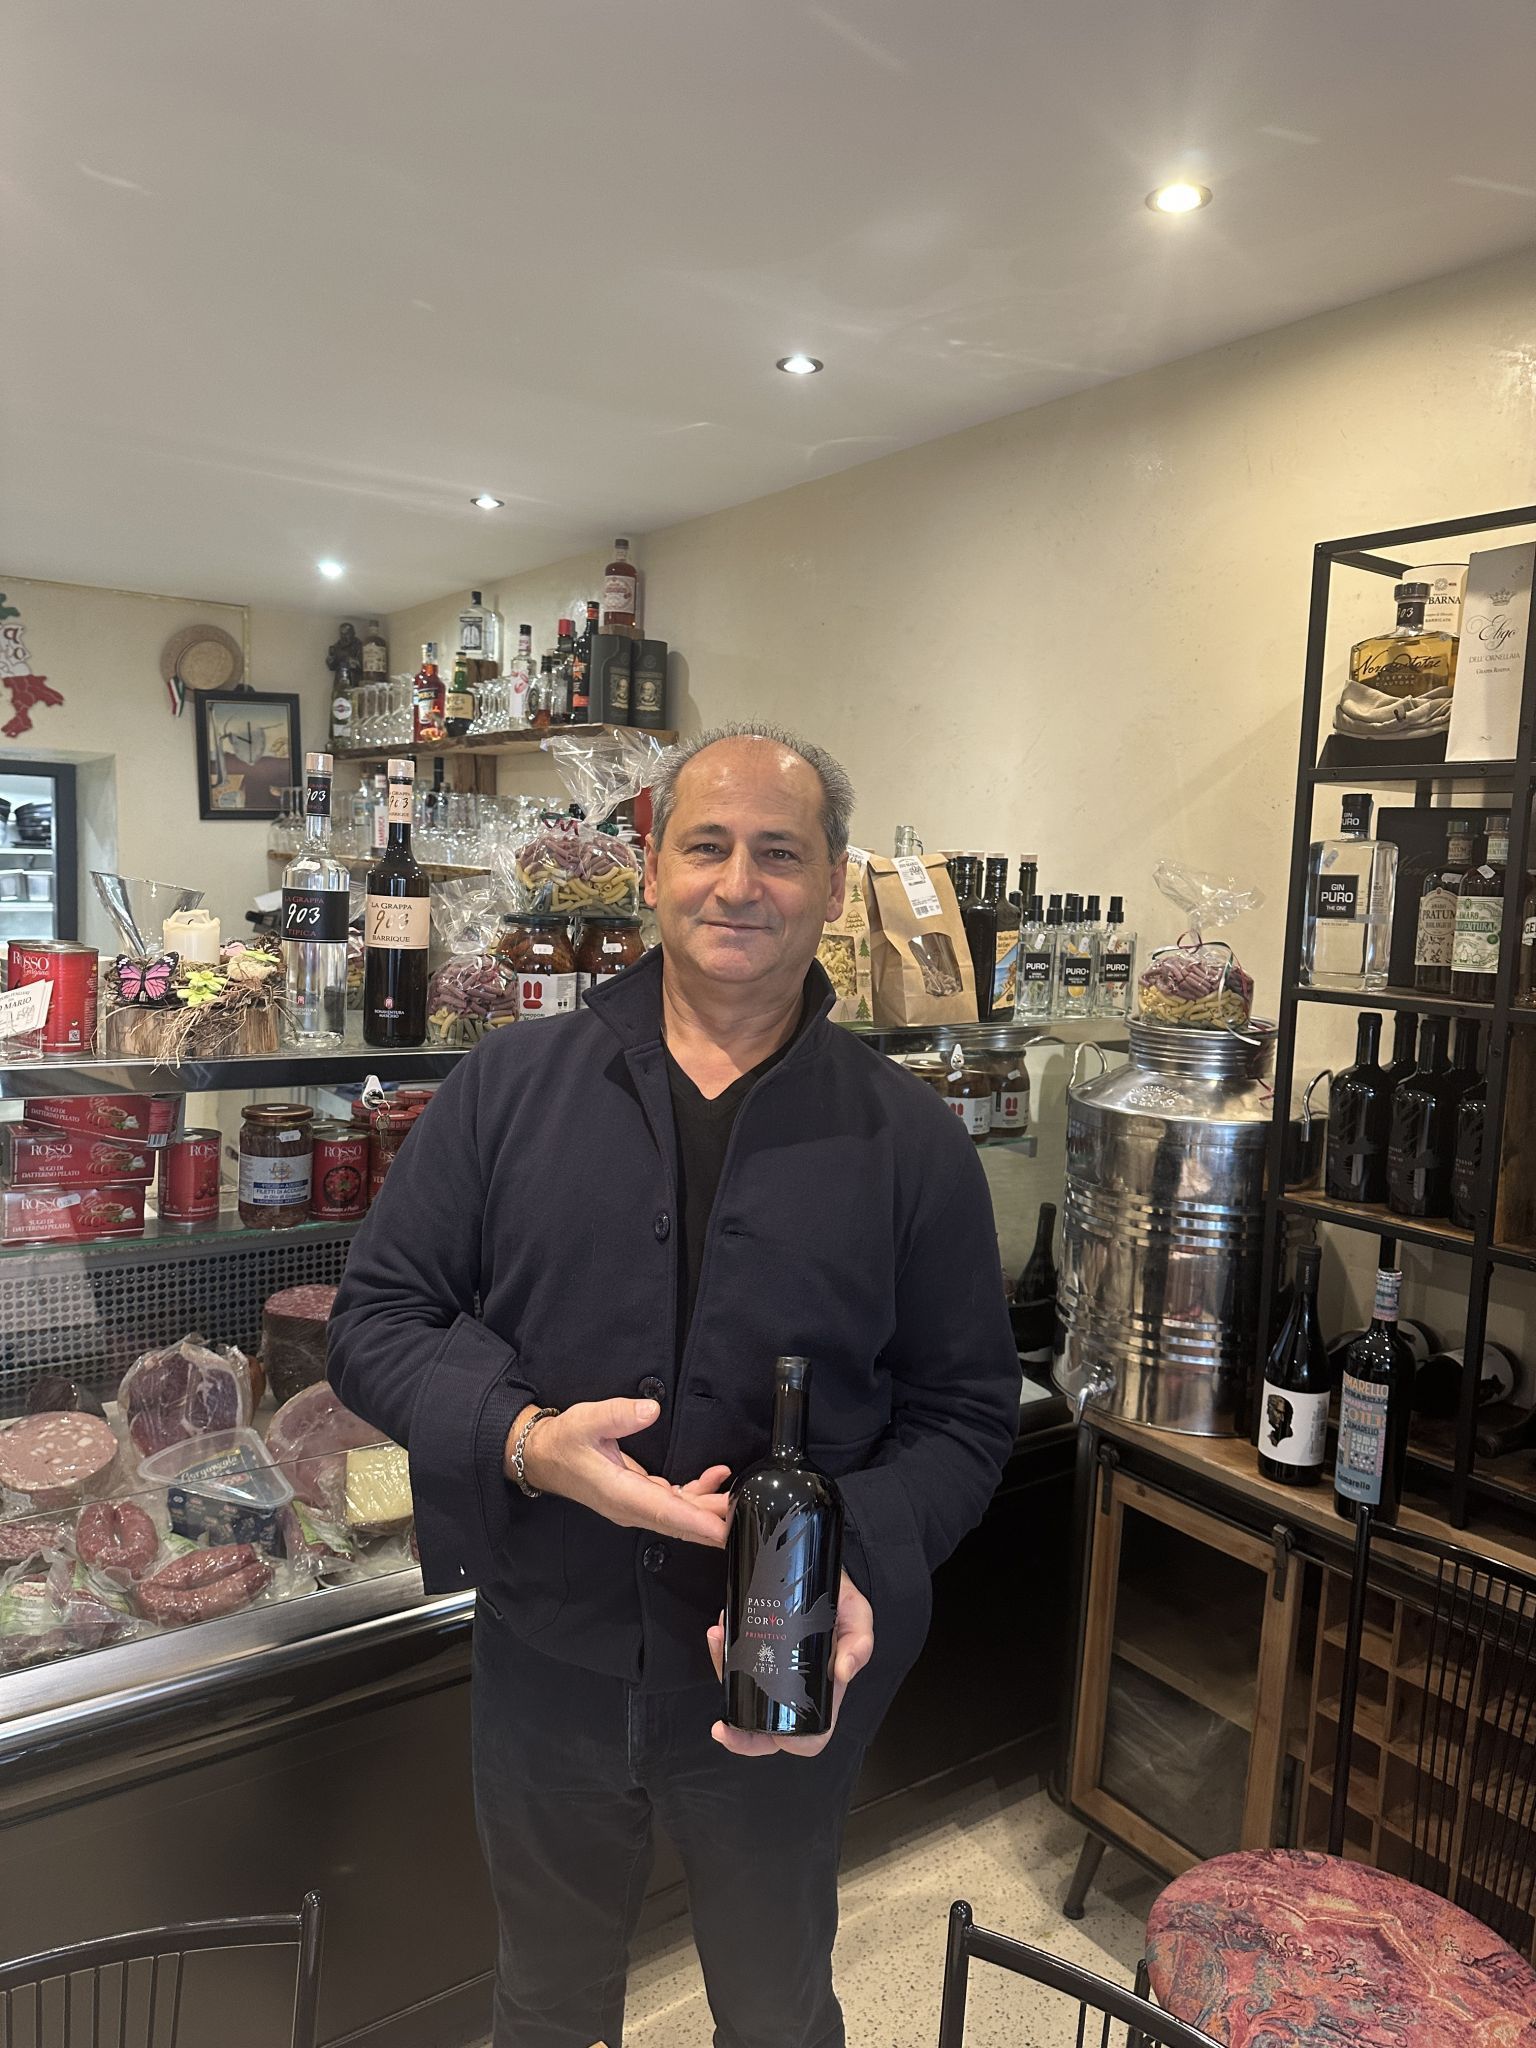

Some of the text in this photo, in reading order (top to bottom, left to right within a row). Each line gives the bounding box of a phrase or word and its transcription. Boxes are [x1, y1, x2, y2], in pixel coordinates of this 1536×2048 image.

[1424, 597, 1462, 605] BARNA
[1342, 817, 1360, 826] URO
[1331, 883, 1345, 891] GIN
[292, 895, 325, 905] GRAPPA
[1320, 891, 1354, 903] PURO
[381, 902, 413, 911] GRAPPA
[286, 903, 321, 929] 903
[374, 909, 410, 935] 903
[287, 928, 317, 937] TIPICA
[1525, 922, 1536, 934] GE
[372, 934, 411, 943] BARRIQUE
[4, 996, 32, 1011] MARIO
[31, 1144, 73, 1157] ROSSO
[189, 1144, 218, 1157] ROSS
[324, 1145, 362, 1158] ROSSO
[748, 1597, 781, 1608] PASSO
[745, 1631, 787, 1640] PRIMITIVO
[752, 1666, 779, 1675] ARPI
